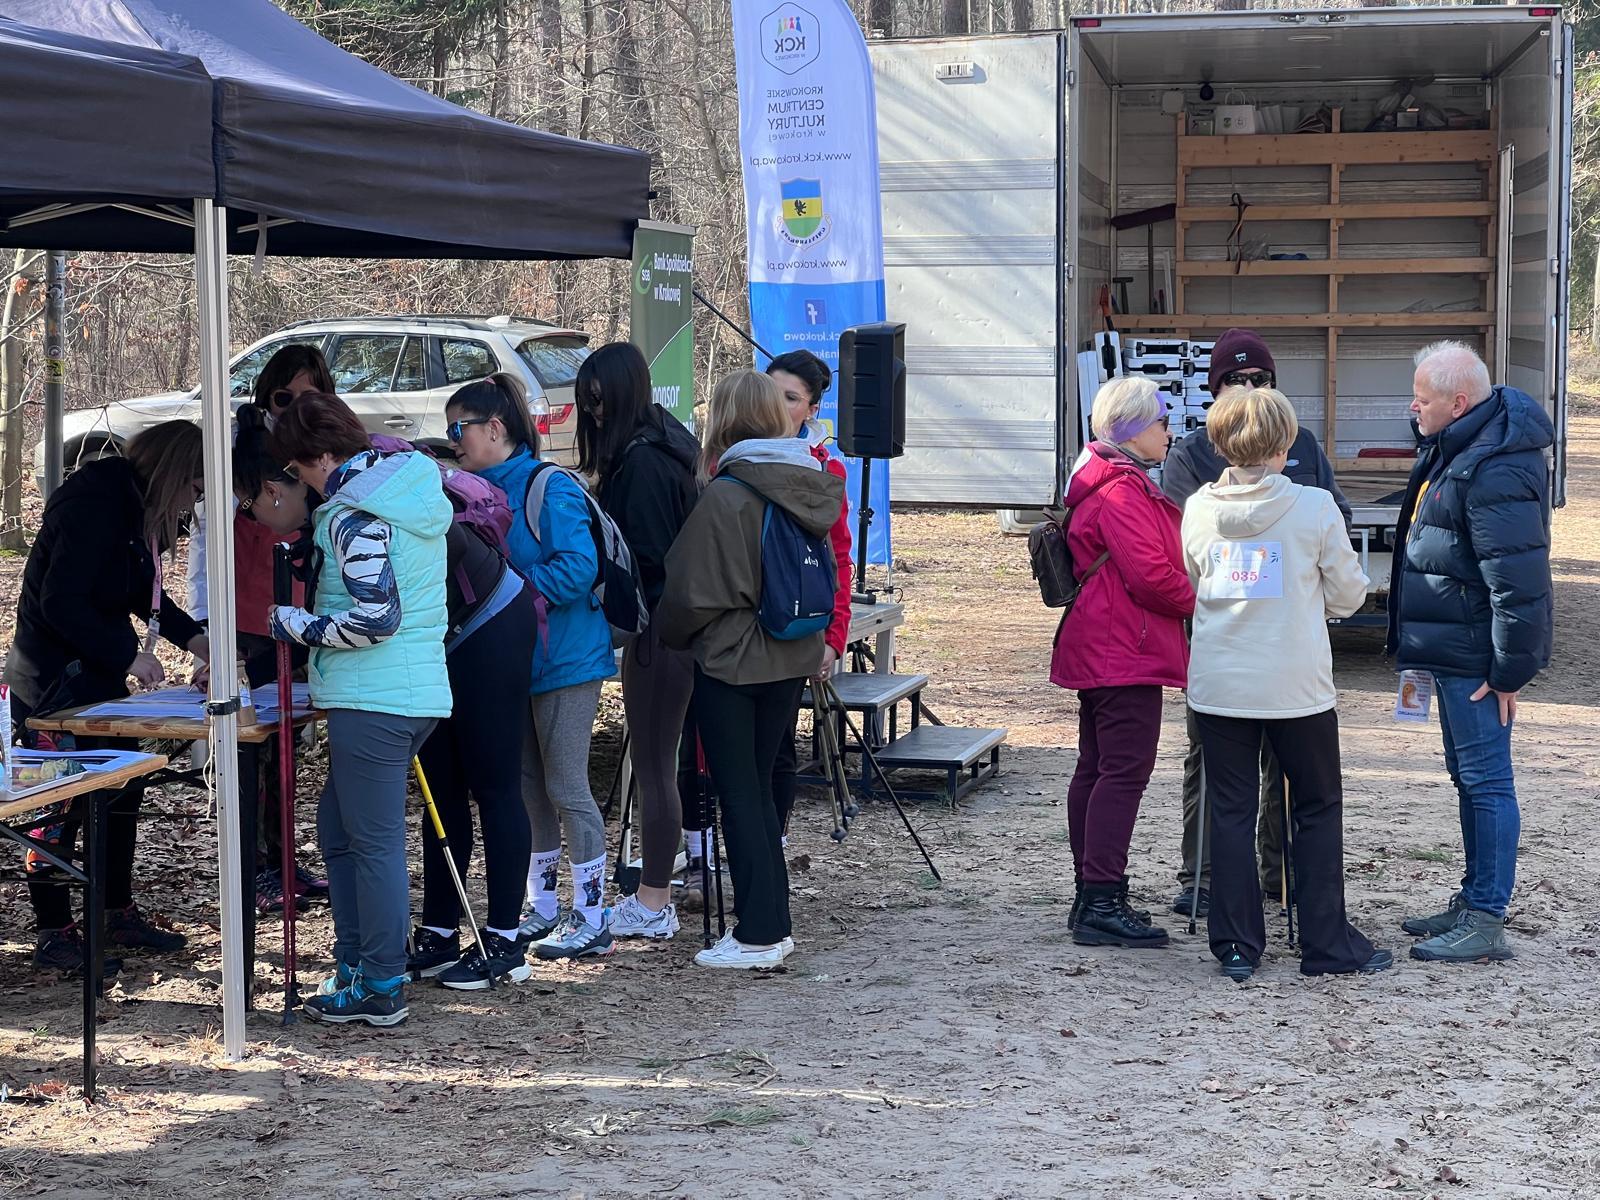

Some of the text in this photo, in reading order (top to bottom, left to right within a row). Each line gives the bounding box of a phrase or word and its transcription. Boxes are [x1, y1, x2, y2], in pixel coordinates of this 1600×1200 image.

[654, 252, 666, 270] Bank
[650, 384, 681, 408] ponsor
[1231, 570, 1258, 582] 035
